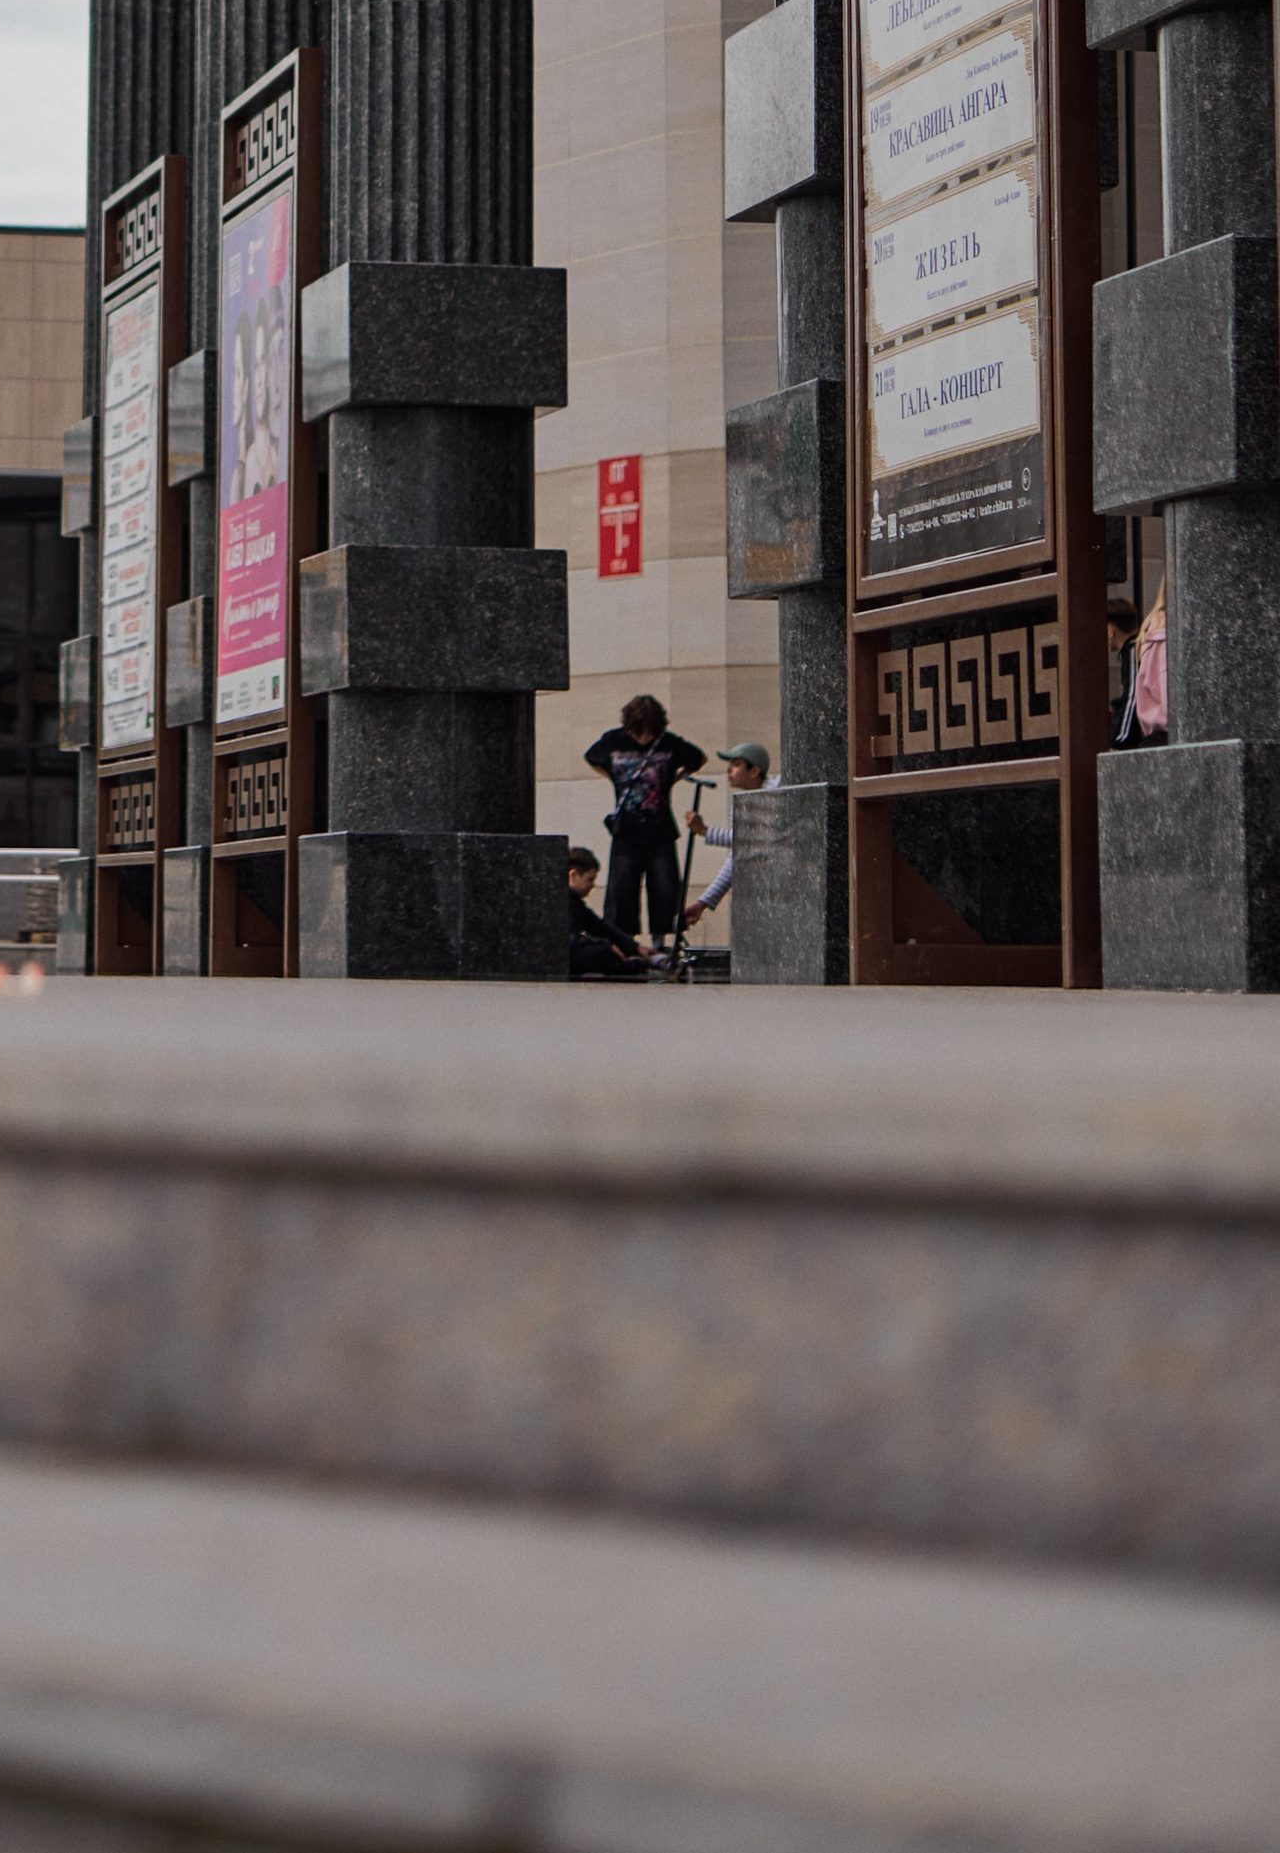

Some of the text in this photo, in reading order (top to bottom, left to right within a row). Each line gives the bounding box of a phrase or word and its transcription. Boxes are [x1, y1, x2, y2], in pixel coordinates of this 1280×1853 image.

[870, 107, 879, 134] 19
[889, 79, 1008, 158] КРАСАВИЦА АНГАРА
[874, 237, 883, 265] 20
[915, 231, 981, 281] ЖИЗЕЛЬ
[875, 372, 883, 398] 21
[900, 385, 931, 420] ГАЛА
[940, 361, 1004, 406] КОНЦЕРТ
